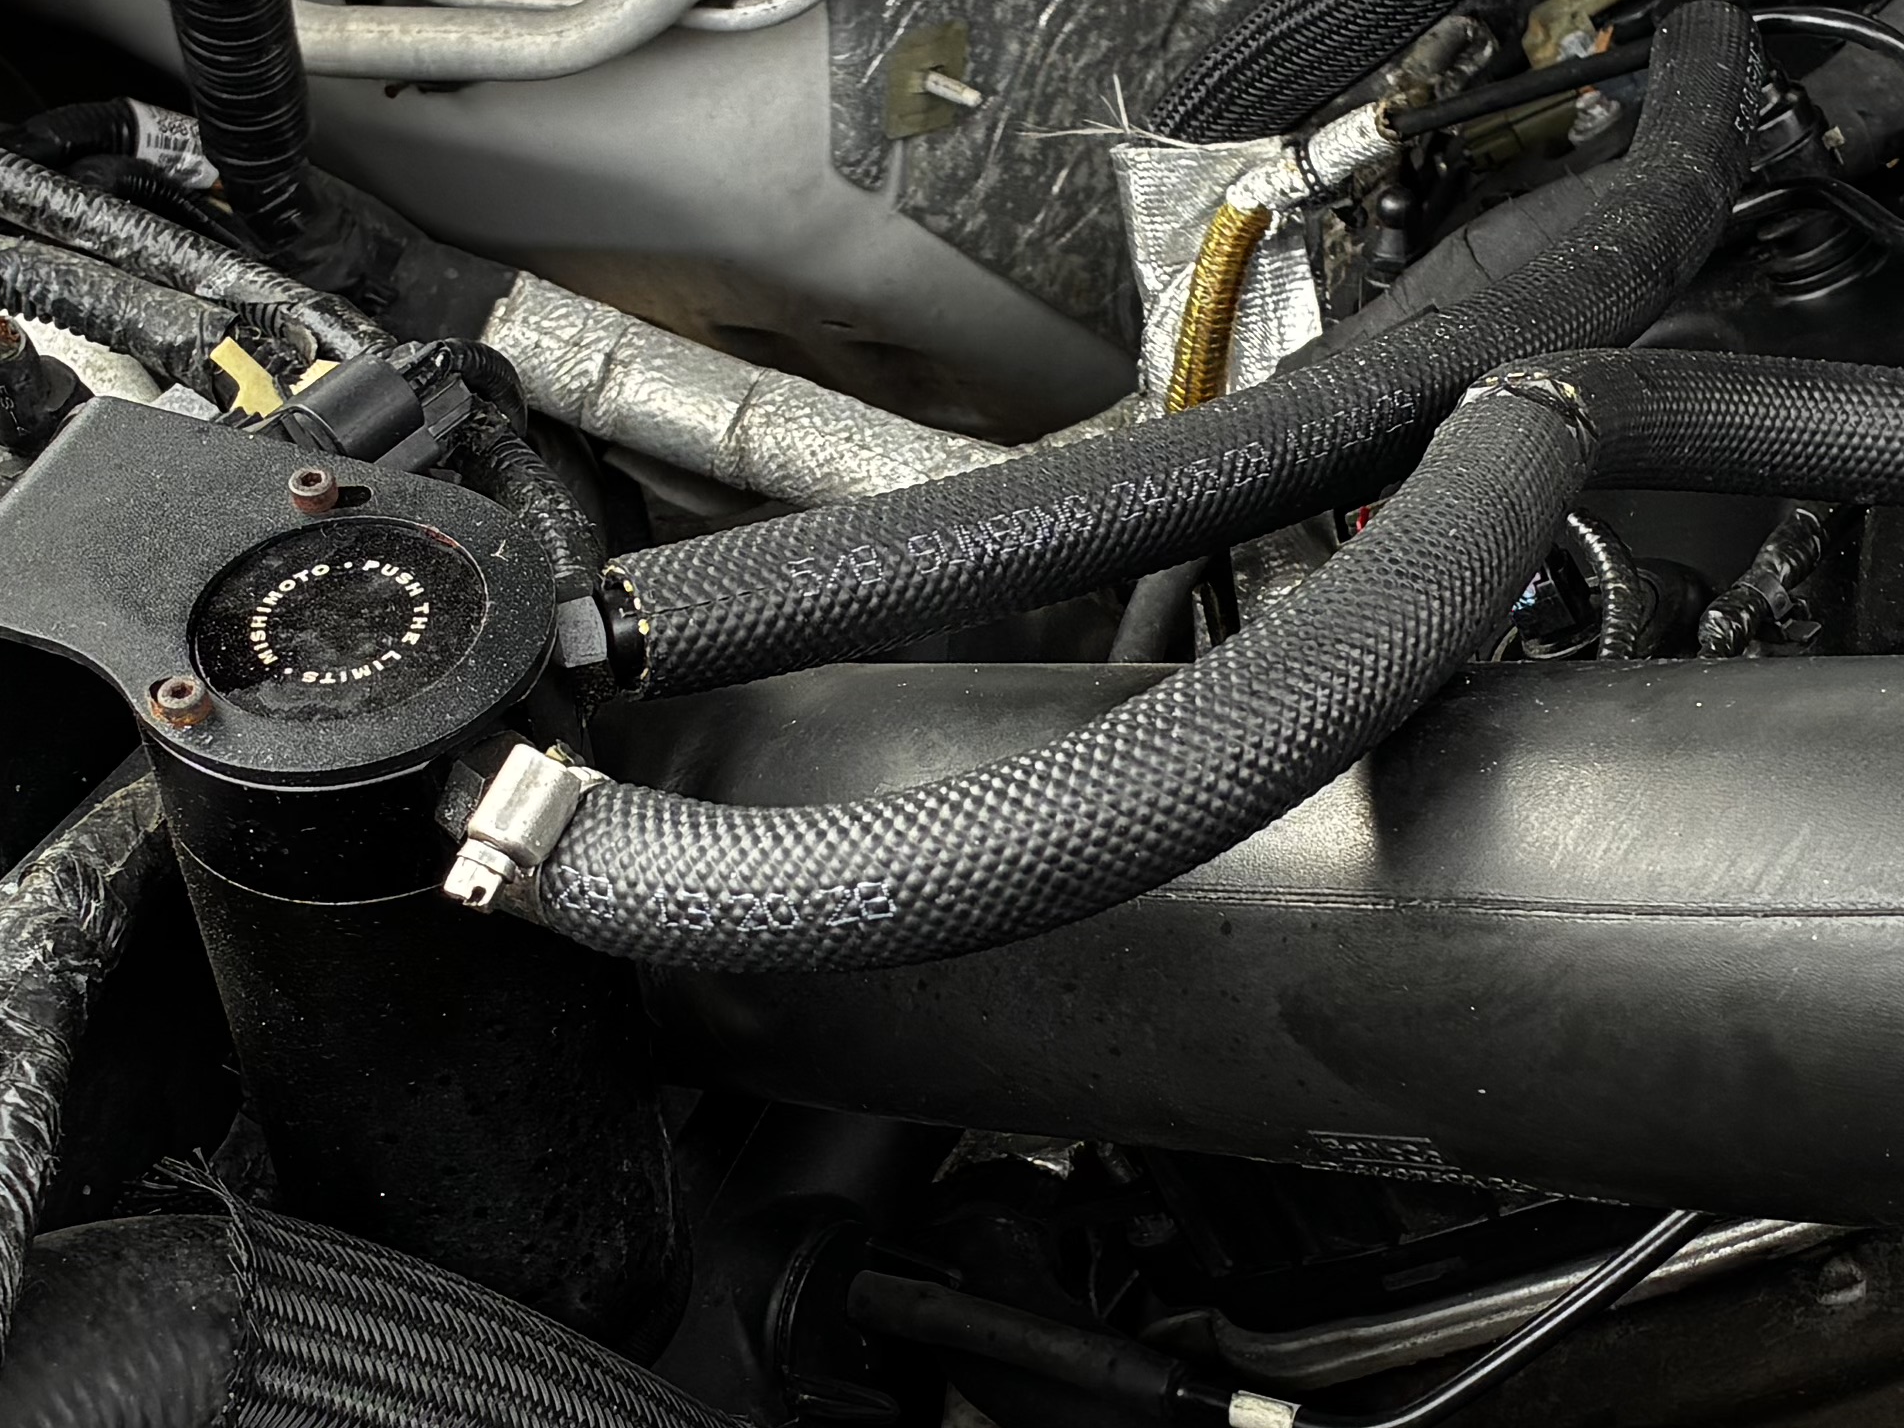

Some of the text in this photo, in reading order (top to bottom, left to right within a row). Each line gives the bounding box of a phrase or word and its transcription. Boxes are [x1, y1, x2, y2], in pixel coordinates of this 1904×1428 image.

[250, 559, 430, 685] MISHIMOTO PUSH THE LIMITS
